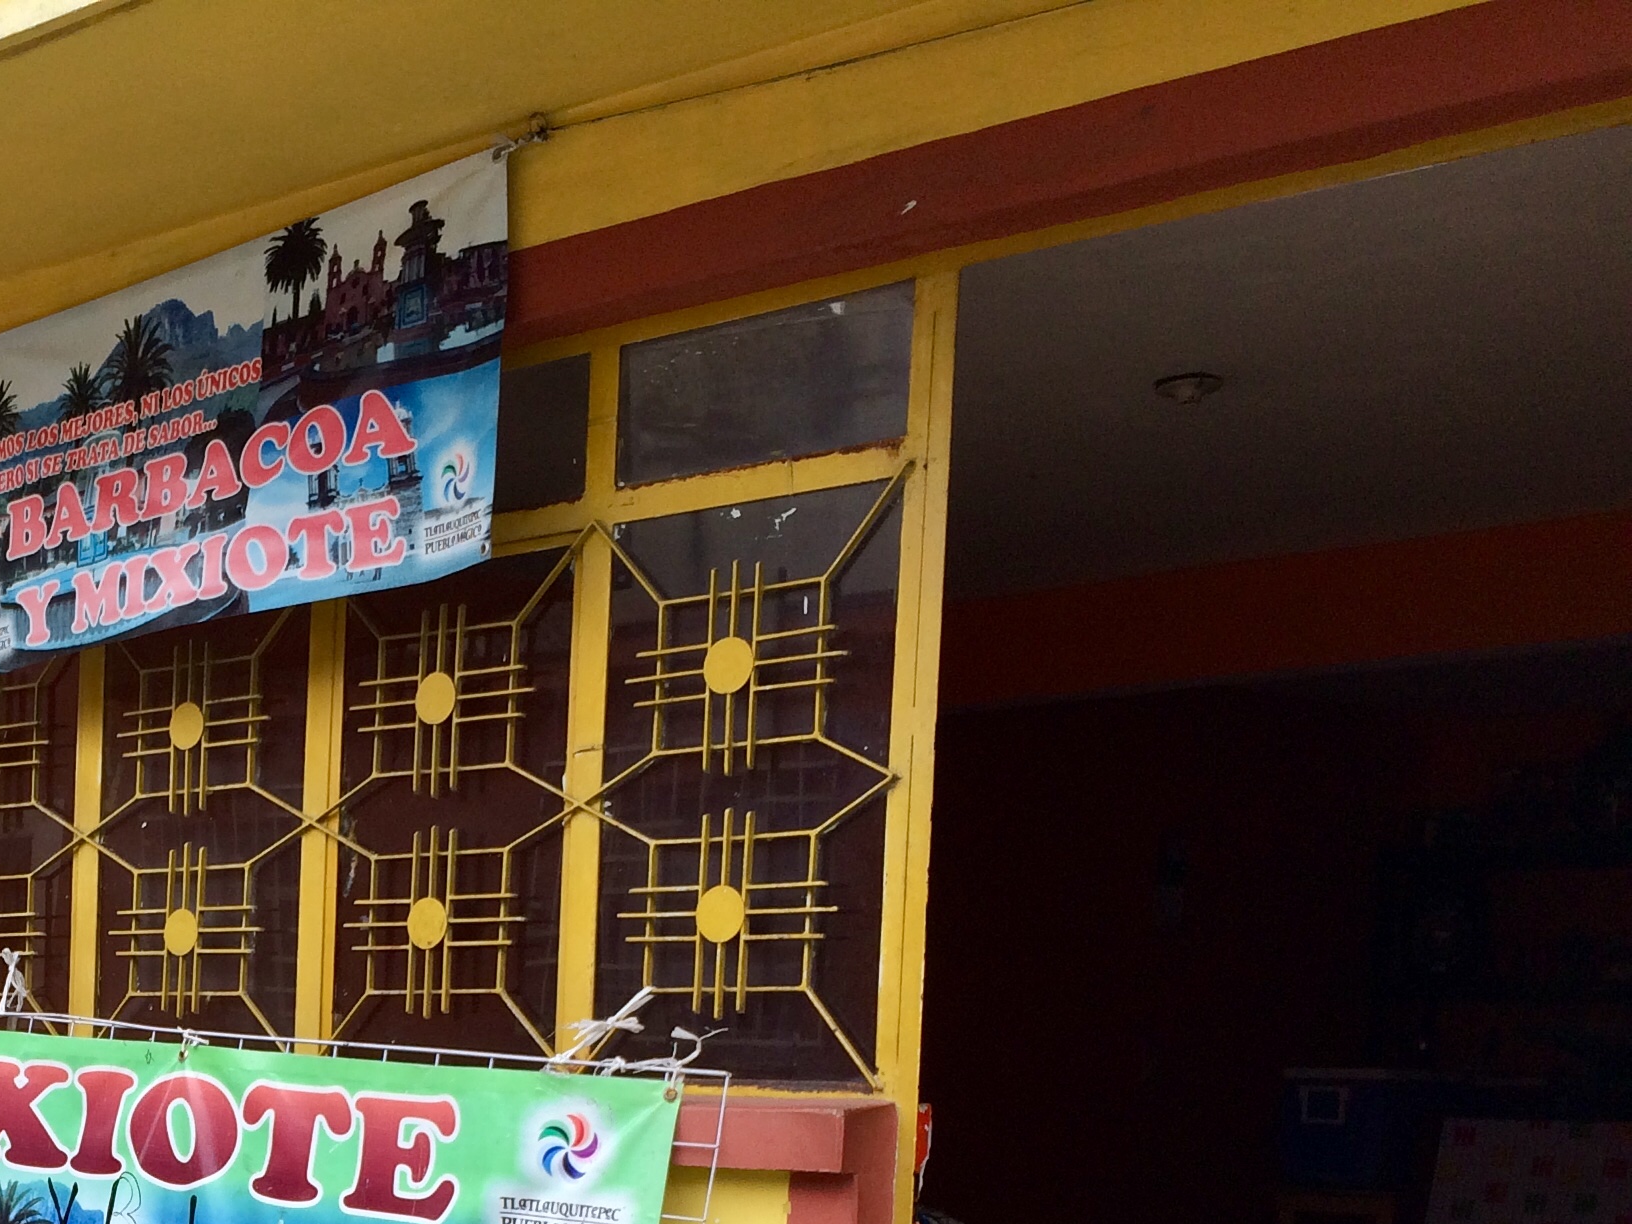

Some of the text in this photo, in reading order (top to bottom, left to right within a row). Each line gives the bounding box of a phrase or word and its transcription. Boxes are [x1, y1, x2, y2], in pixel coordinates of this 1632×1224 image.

[26, 426, 58, 450] LOS
[59, 401, 137, 443] MEJORES,
[140, 393, 160, 419] NI
[162, 380, 194, 411] LOS
[195, 357, 263, 399] ÚNICOS
[26, 457, 41, 482] SI
[42, 453, 62, 478] SE
[66, 437, 119, 472] TRATA
[122, 429, 145, 457] DE
[147, 409, 218, 443] SABOR...
[5, 389, 417, 561] BARBACOA
[16, 496, 407, 647] Y MIXIOTE
